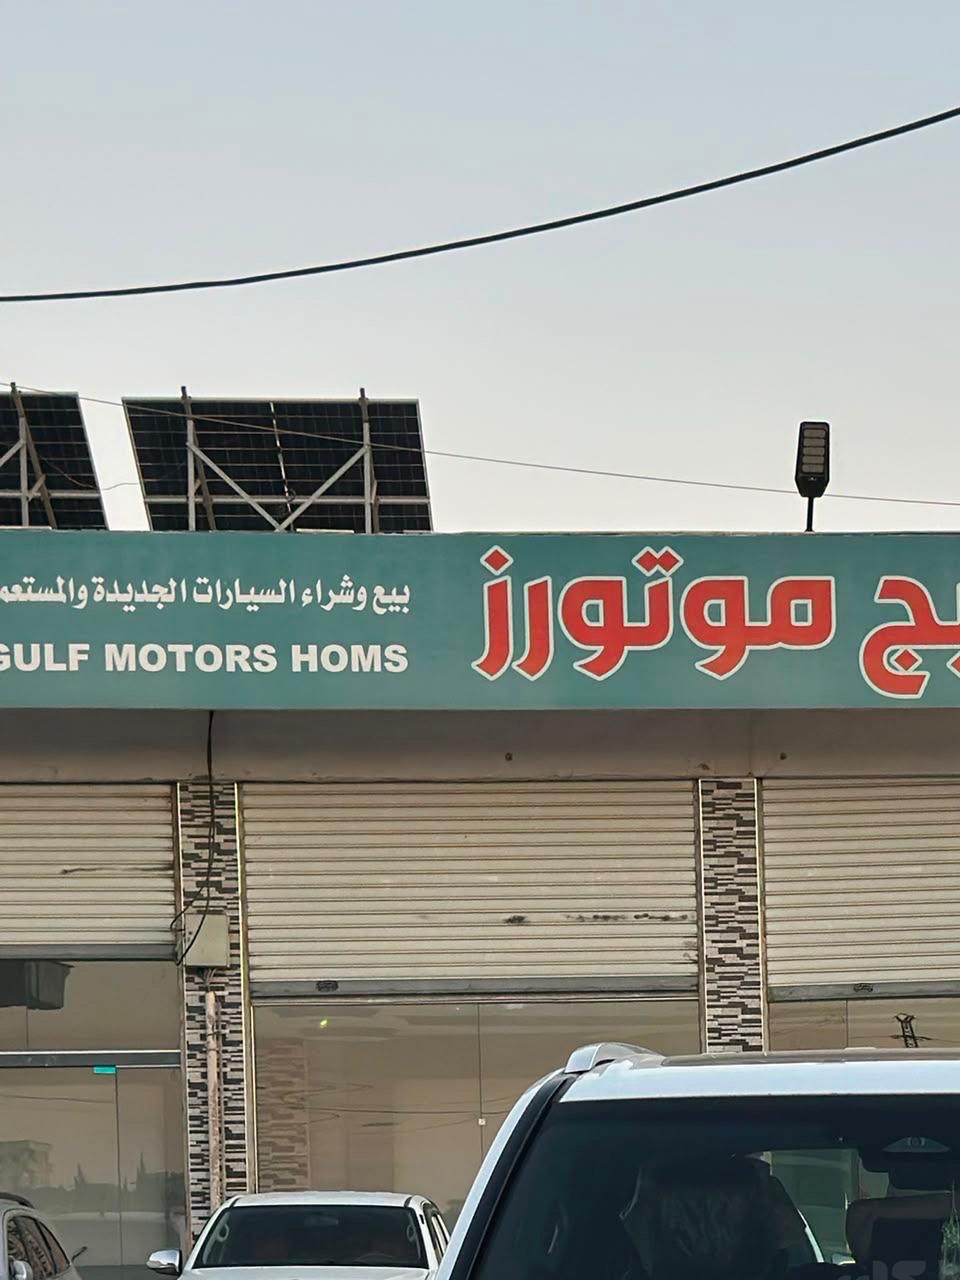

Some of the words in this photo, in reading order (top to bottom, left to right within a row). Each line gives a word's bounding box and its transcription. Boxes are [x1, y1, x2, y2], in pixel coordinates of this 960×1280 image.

[91, 575, 187, 612] الجديدة
[192, 576, 296, 613] السيارات
[301, 574, 368, 612] وشراء
[372, 583, 411, 615] بيع
[470, 545, 836, 682] موتورز
[104, 643, 278, 674] MOTORS
[291, 643, 409, 673] HOMS
